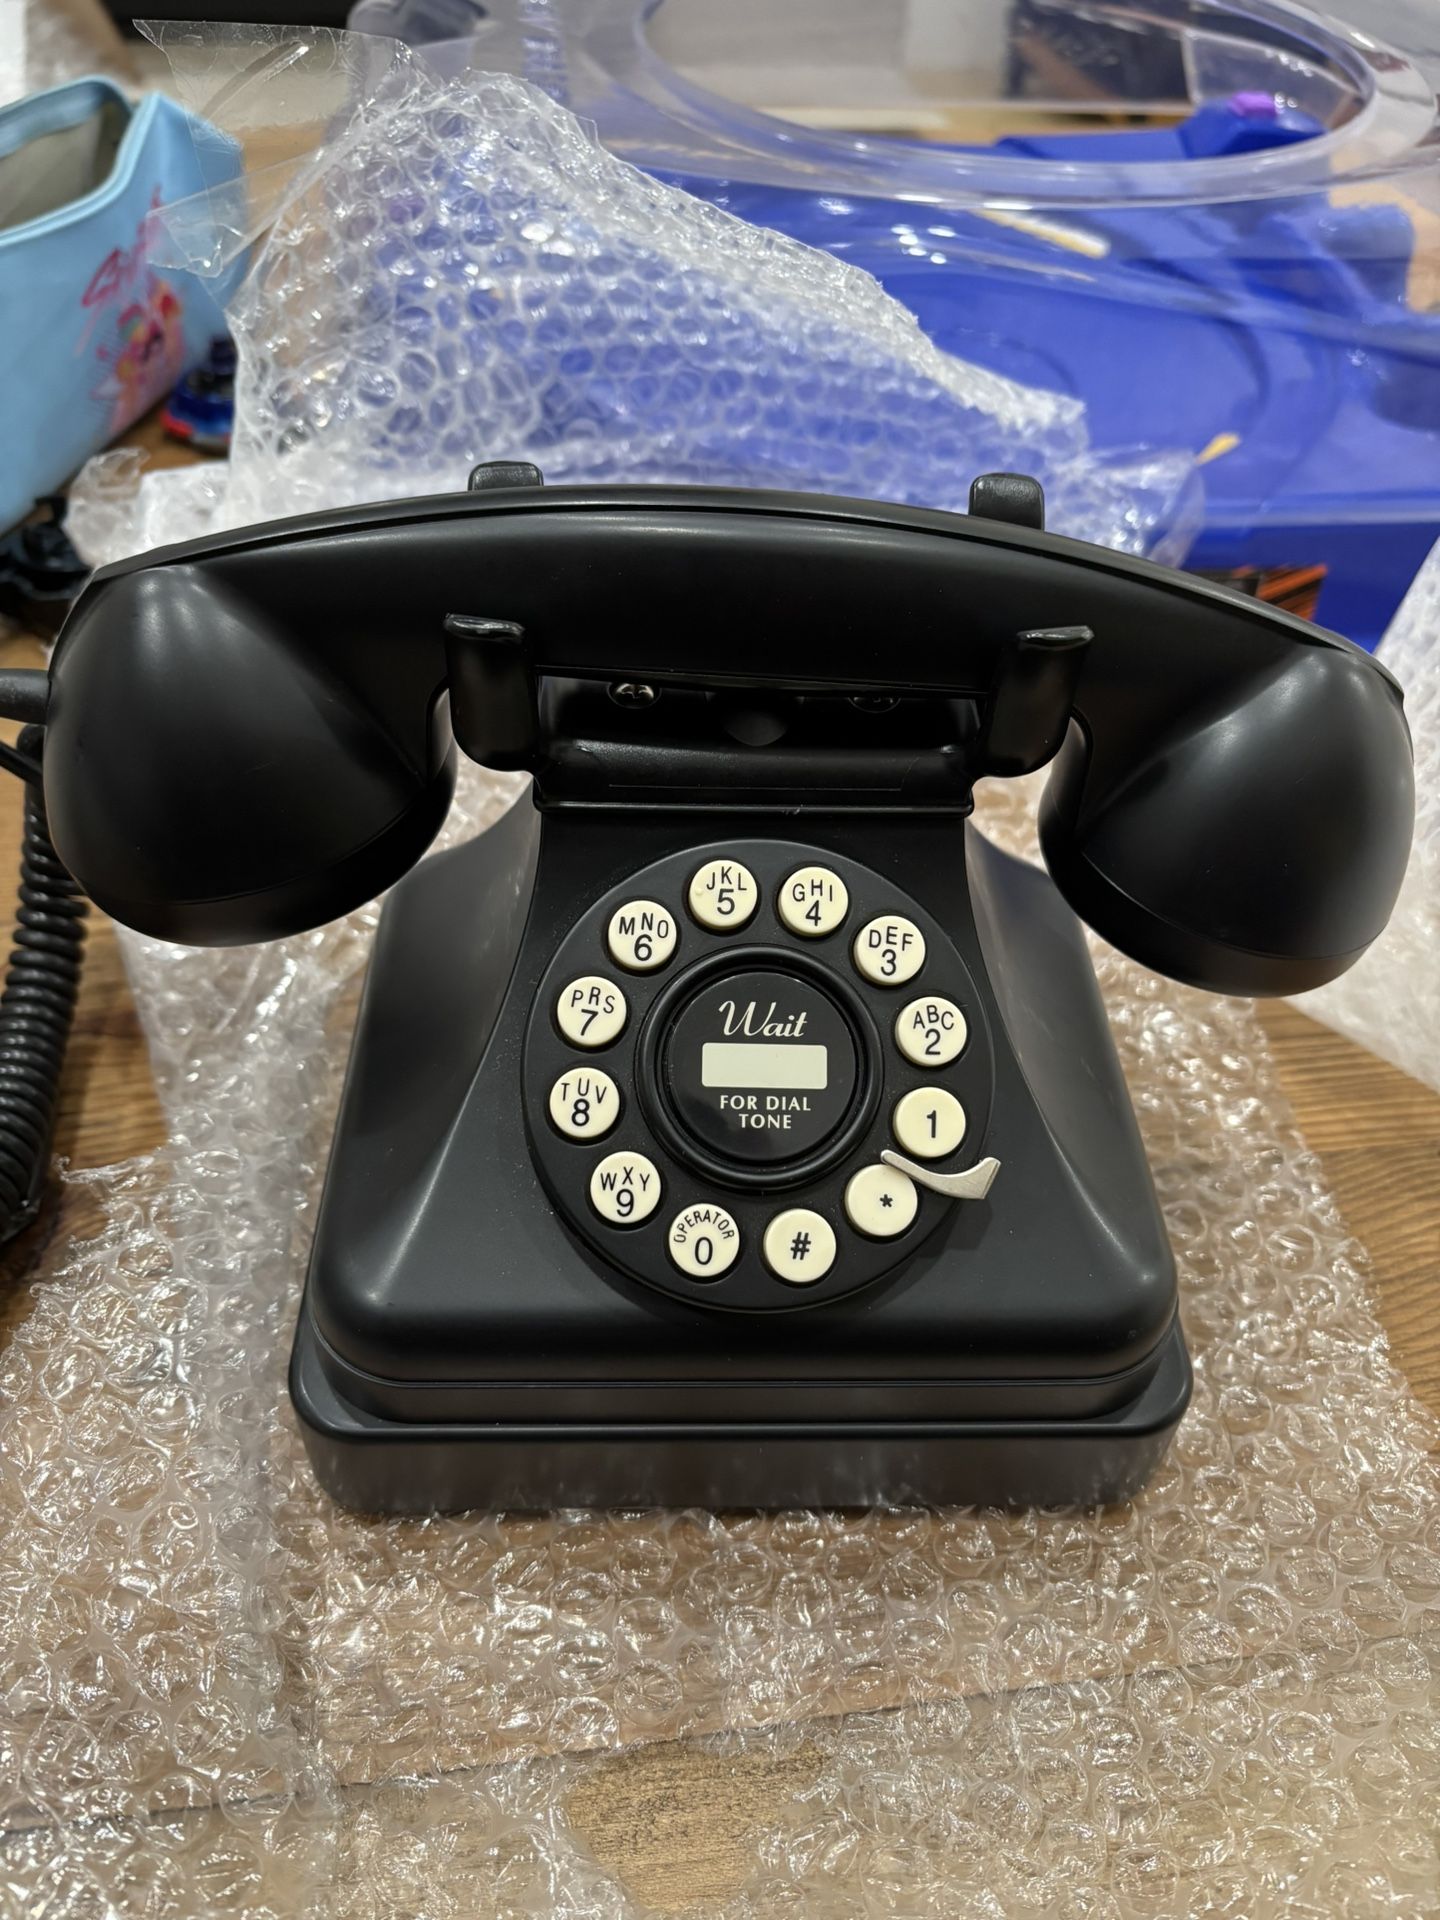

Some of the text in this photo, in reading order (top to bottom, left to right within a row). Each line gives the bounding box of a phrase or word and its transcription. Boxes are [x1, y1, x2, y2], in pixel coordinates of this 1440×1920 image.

[706, 866, 747, 891] JKL
[792, 879, 833, 902] GHI
[716, 888, 735, 915] 5
[805, 900, 821, 926] 4
[619, 912, 669, 938] MNO
[869, 926, 913, 951] DEF
[634, 934, 653, 961] 6
[880, 949, 896, 976] 3
[571, 986, 615, 1014] PRS
[580, 1008, 599, 1036] 7
[718, 1000, 808, 1038] Wait
[913, 1004, 955, 1030] ABC
[925, 1028, 941, 1055] 2
[561, 1077, 607, 1104] TUV
[720, 1095, 811, 1111] FOR DIAL
[571, 1098, 590, 1127] 8
[738, 1113, 792, 1129] TONE
[926, 1110, 937, 1139] 1
[600, 1166, 650, 1191] WXY
[616, 1188, 635, 1217] 9
[673, 1209, 735, 1243] OPERATOR
[694, 1236, 714, 1265] 0
[790, 1231, 812, 1260] #
